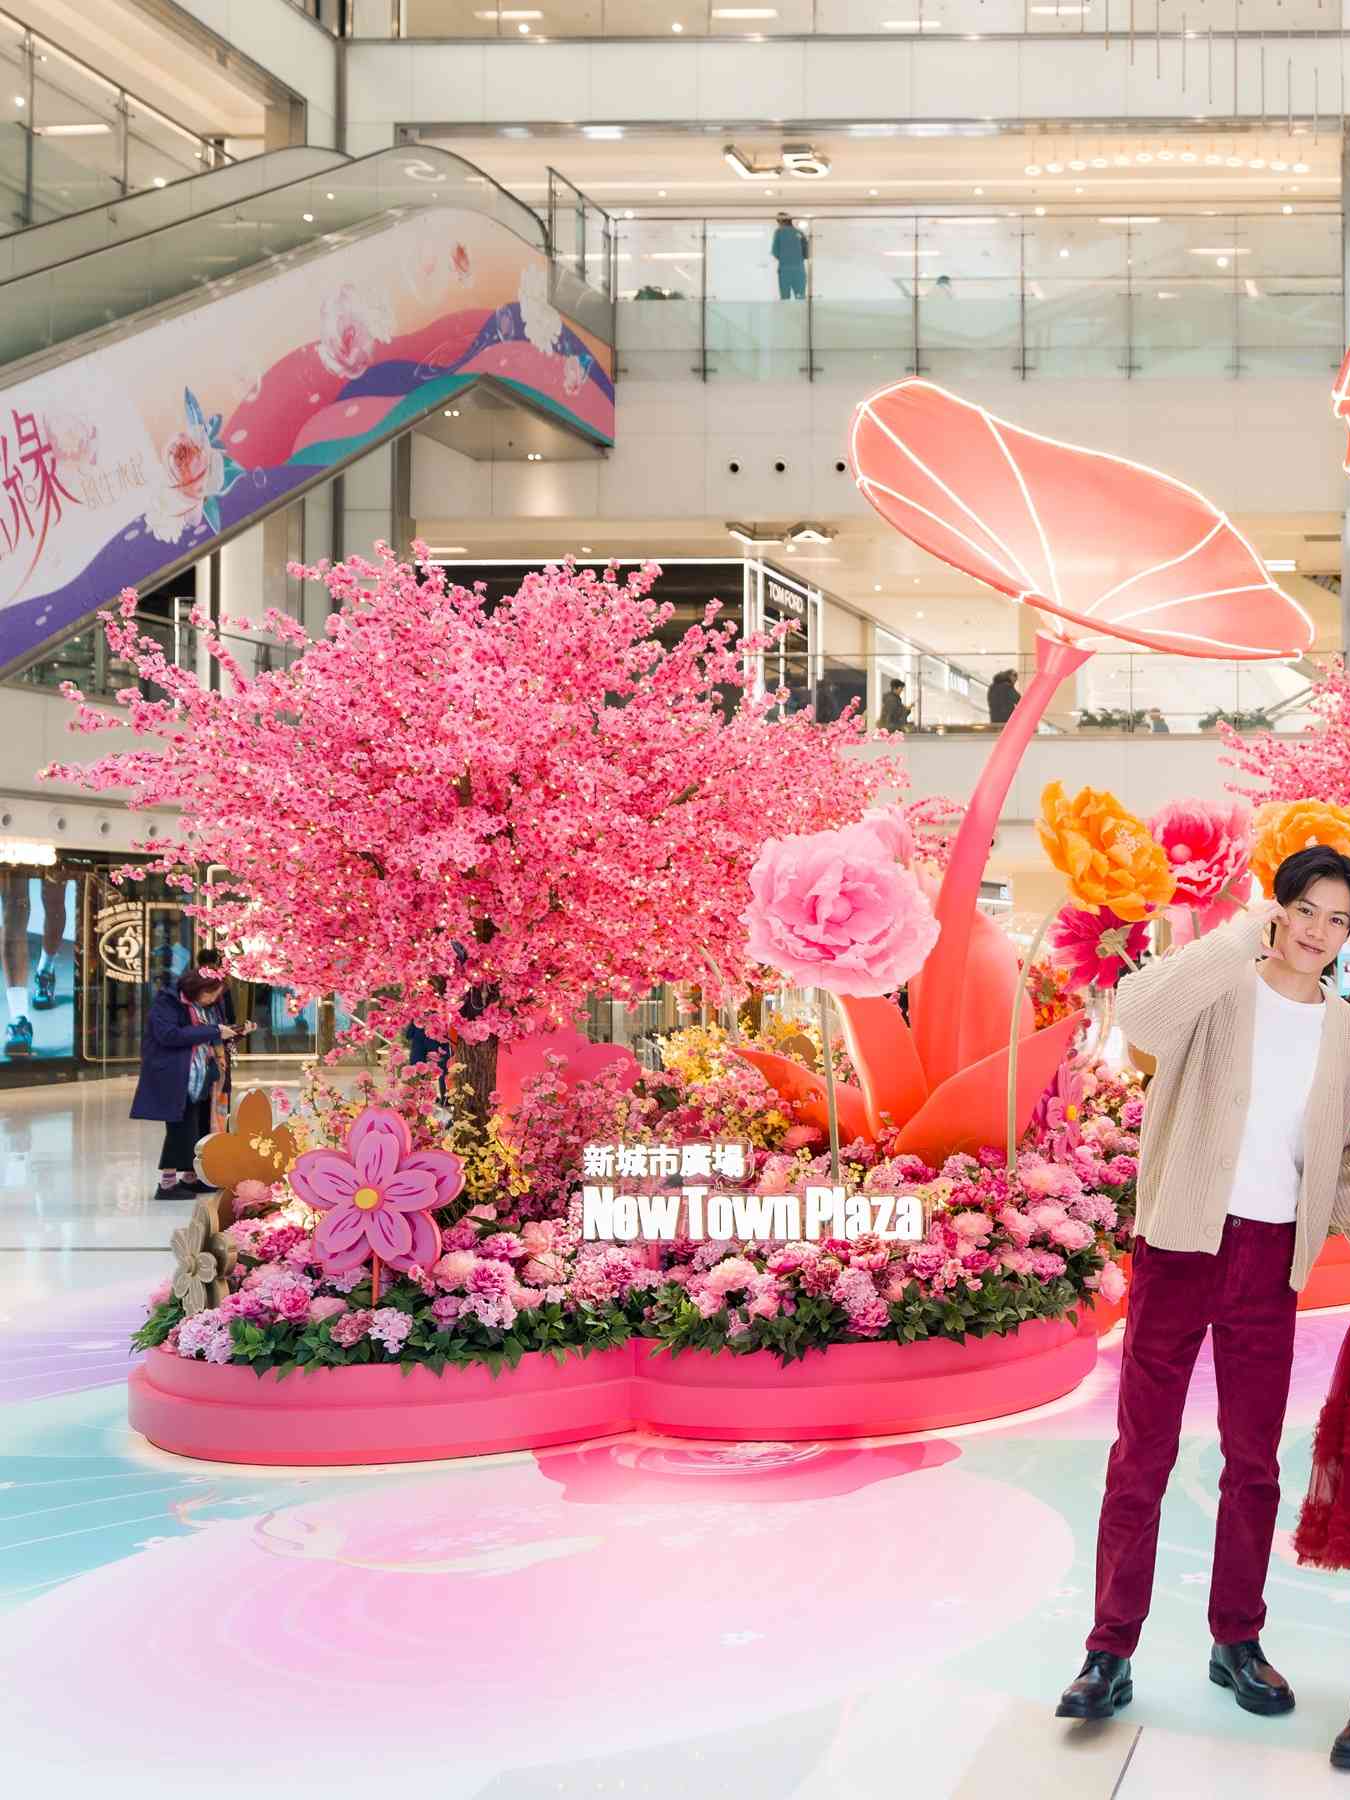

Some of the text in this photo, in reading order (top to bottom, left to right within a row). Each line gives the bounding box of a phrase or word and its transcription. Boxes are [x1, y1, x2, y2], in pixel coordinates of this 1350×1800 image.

[768, 581, 803, 614] TOM FORD
[583, 1144, 744, 1177] 新城市廣場
[583, 1186, 922, 1240] New Town Plaza
